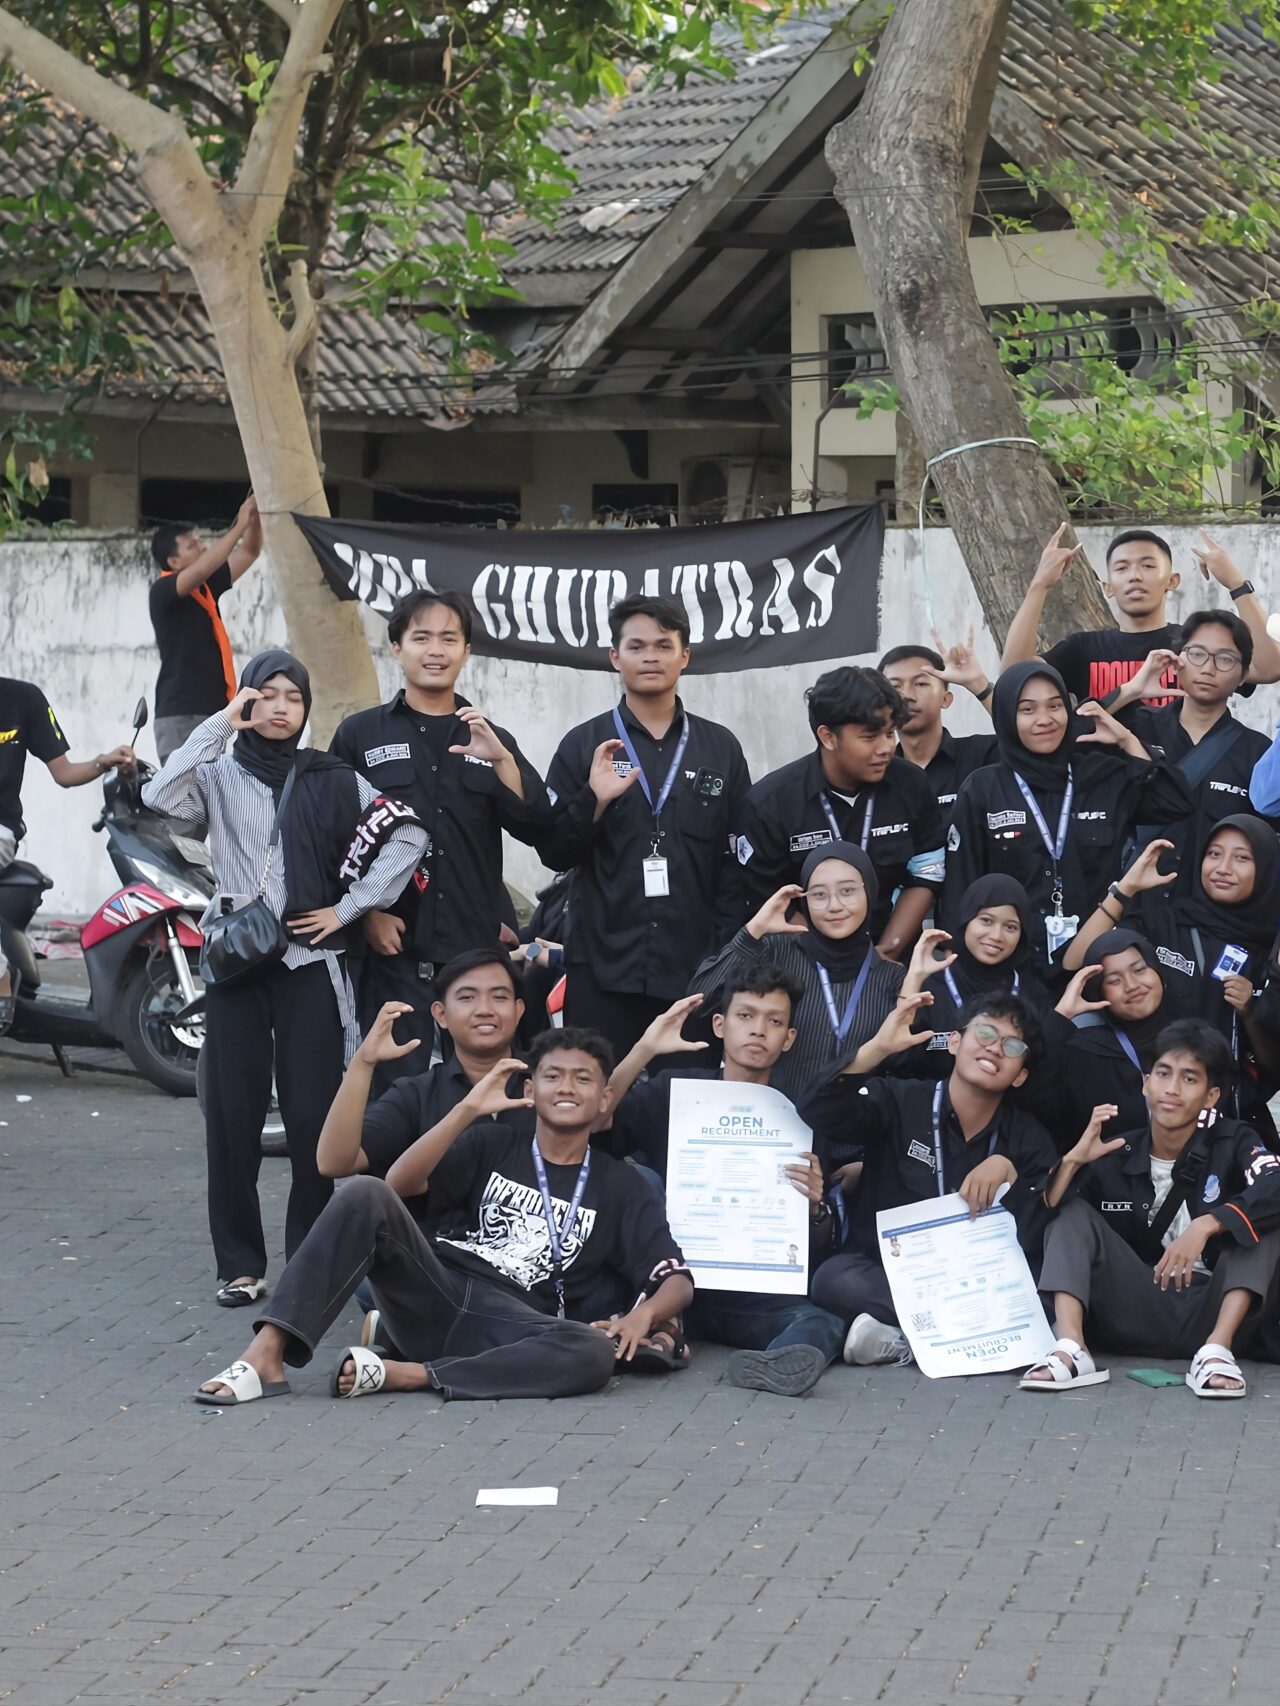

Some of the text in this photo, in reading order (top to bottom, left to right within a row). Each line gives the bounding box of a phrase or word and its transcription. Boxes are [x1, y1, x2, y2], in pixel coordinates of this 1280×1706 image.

[719, 1116, 763, 1127] OPEN
[701, 1127, 781, 1136] RECRUITMENT
[947, 1335, 1022, 1354] RECRUITMENT
[966, 1345, 1008, 1358] OPEN
